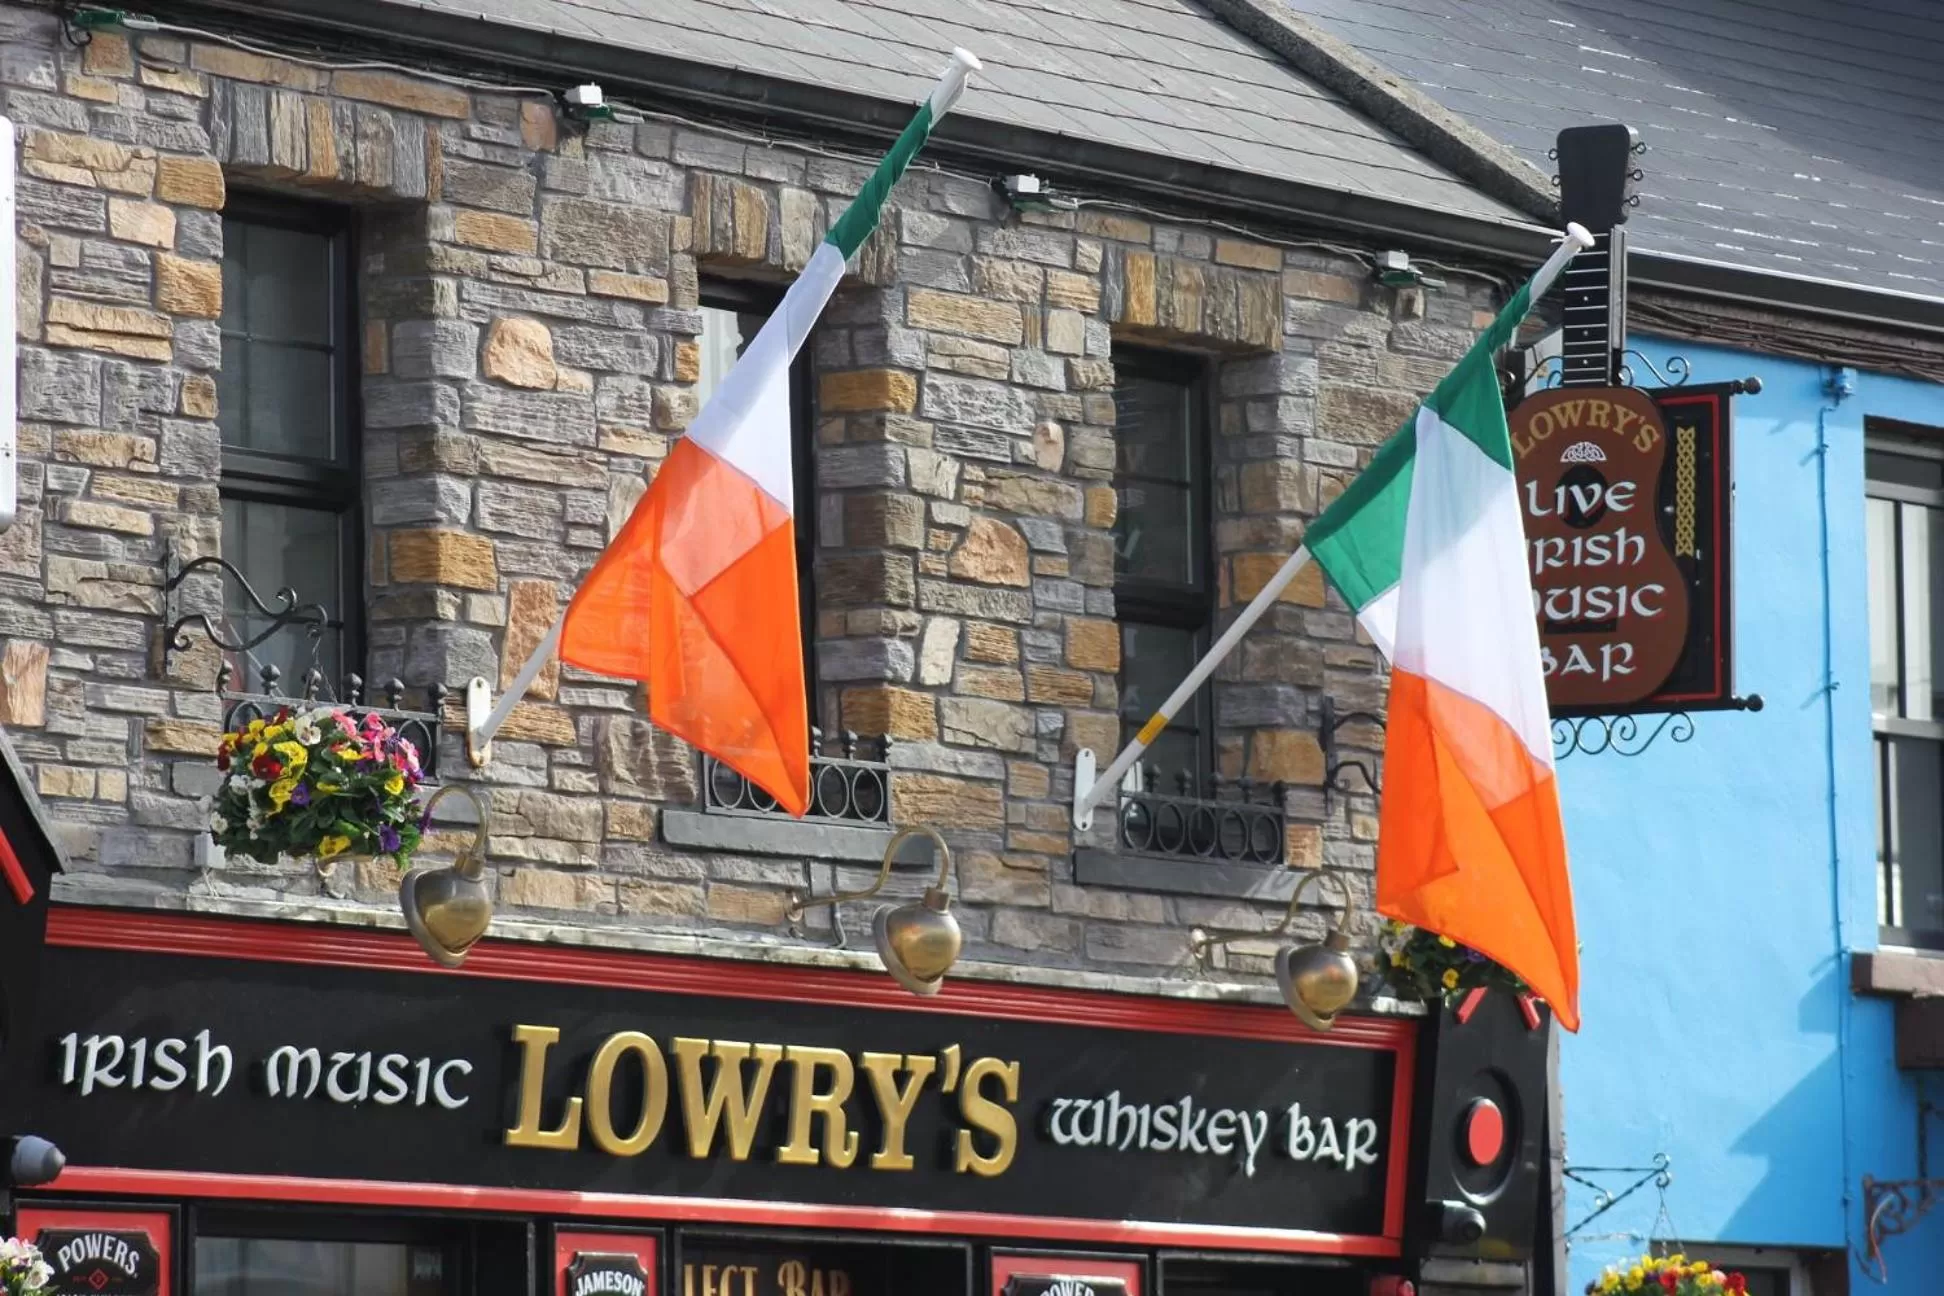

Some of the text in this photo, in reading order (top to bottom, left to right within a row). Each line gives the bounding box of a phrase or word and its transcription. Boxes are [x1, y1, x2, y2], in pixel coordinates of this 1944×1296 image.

[1511, 399, 1661, 459] LOWRY'S
[1532, 584, 1666, 621] USIC
[505, 1024, 1021, 1177] LOWRY'S
[57, 1233, 140, 1276] POWERS
[575, 1271, 643, 1296] JAMESON
